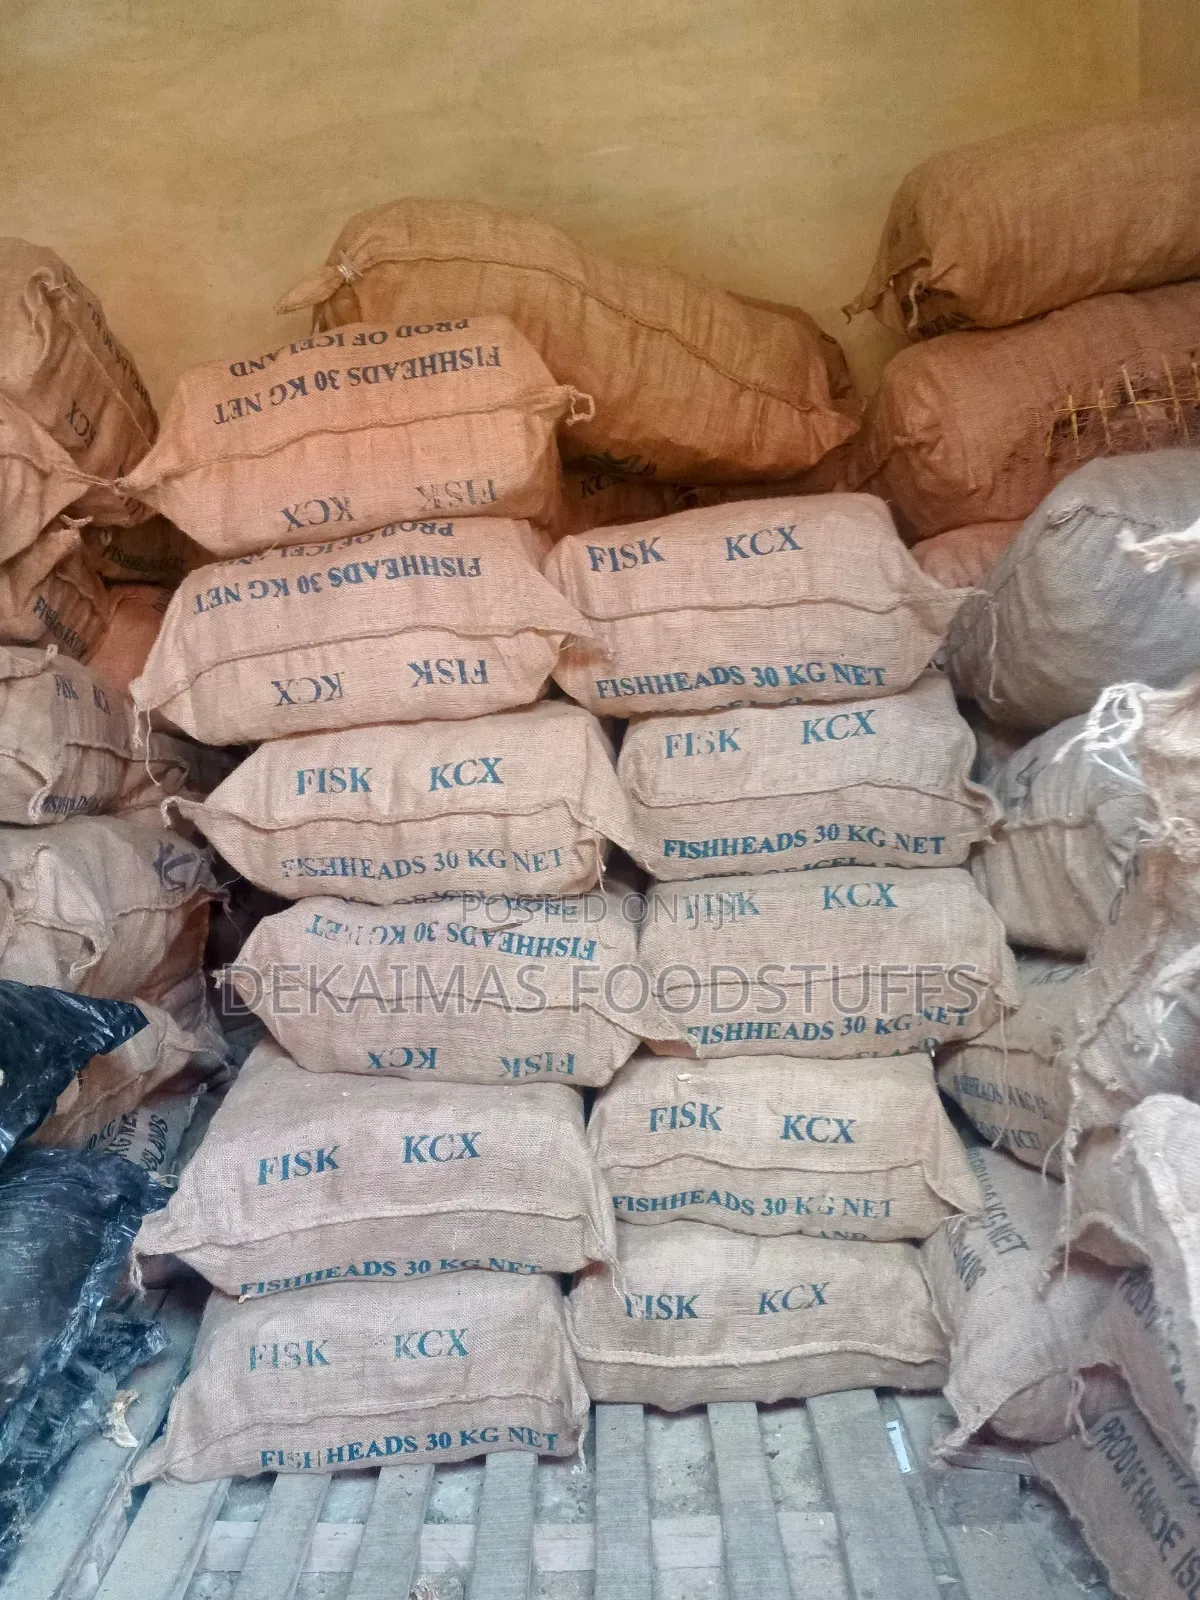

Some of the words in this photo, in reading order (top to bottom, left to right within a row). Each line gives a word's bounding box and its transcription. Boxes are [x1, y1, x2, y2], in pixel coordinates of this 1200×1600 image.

[352, 331, 389, 346] OF
[396, 318, 470, 338] PROD
[314, 369, 340, 391] 30
[347, 346, 502, 387] FISHHEADS
[269, 376, 310, 408] KG
[213, 393, 263, 425] NET
[416, 479, 497, 511] FISK
[280, 495, 356, 533] KCX
[381, 521, 454, 538] PROD
[586, 536, 665, 573] FISK
[724, 524, 803, 562] KCX
[297, 573, 322, 594] 30
[328, 555, 482, 588] FISHHEADS
[193, 583, 243, 615] NET
[249, 577, 290, 600] KG
[272, 672, 345, 706] KCX
[407, 659, 489, 688] FISK
[596, 665, 745, 699] FISHHEADS
[750, 666, 780, 688] 30
[784, 662, 826, 686] KG
[828, 662, 887, 687] NET
[664, 727, 741, 759] FISK
[800, 709, 877, 745] KCX
[295, 766, 373, 796] FISK
[428, 757, 504, 793] KCX
[663, 828, 808, 860] FISHHEADS
[813, 823, 841, 844] 30
[847, 824, 887, 848] KG
[894, 832, 946, 855] NET
[433, 852, 460, 872] 30
[467, 848, 507, 870] KG
[513, 846, 564, 873] NET
[822, 882, 899, 911] KCX
[413, 920, 440, 943] 30
[446, 921, 597, 962] FISHHEADS
[685, 1020, 835, 1045] FISHHEADS
[840, 1015, 867, 1037] 30
[874, 1013, 912, 1036] KG
[918, 1005, 969, 1027] NET
[368, 1046, 438, 1070] KCX
[500, 1051, 576, 1079] FISK
[648, 1101, 724, 1133] FISK
[780, 1113, 857, 1144] KCX
[257, 1144, 342, 1187] FISK
[401, 1131, 482, 1165] KCX
[612, 1189, 755, 1217] FISHHEADS
[760, 1197, 787, 1218] 30
[843, 1198, 893, 1219] NET
[240, 1259, 398, 1297] FISHHEADS
[404, 1259, 432, 1277] 30
[439, 1258, 481, 1271] KG
[488, 1256, 543, 1275] NET
[625, 1293, 699, 1320] FISK
[758, 1281, 829, 1315] KCX
[248, 1339, 331, 1372] FISK
[393, 1328, 471, 1360] KCX
[425, 1431, 453, 1451] 30
[460, 1427, 500, 1447] KG
[507, 1426, 560, 1451] NET
